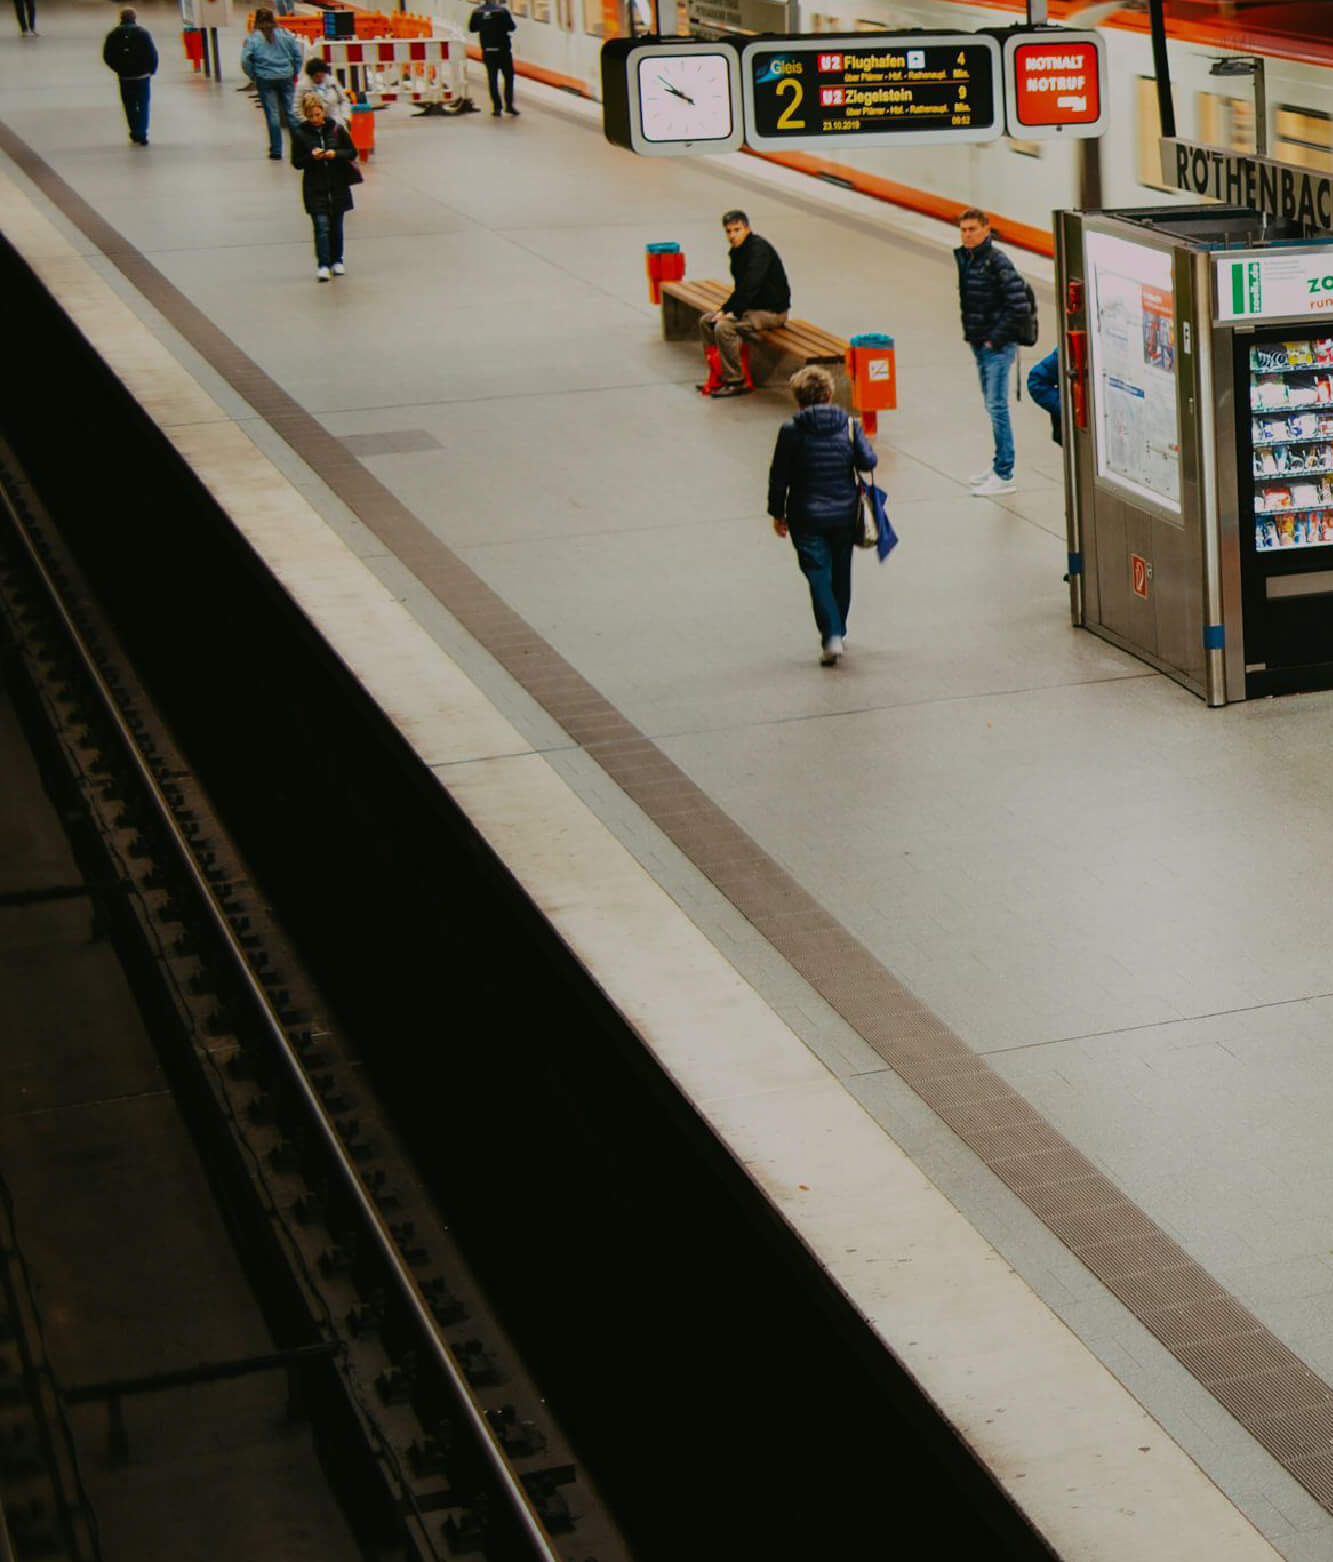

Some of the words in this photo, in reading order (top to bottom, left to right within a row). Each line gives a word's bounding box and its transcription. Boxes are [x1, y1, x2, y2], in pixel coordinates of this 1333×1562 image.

[769, 59, 803, 74] Gleis
[821, 56, 841, 71] U2
[844, 53, 905, 72] Flughafen
[957, 51, 966, 66] 4
[1025, 55, 1084, 71] NOTHALT
[1026, 75, 1086, 92] NOTRUF
[776, 77, 806, 129] 2
[822, 89, 842, 106] U2
[845, 88, 912, 106] Ziegelstein
